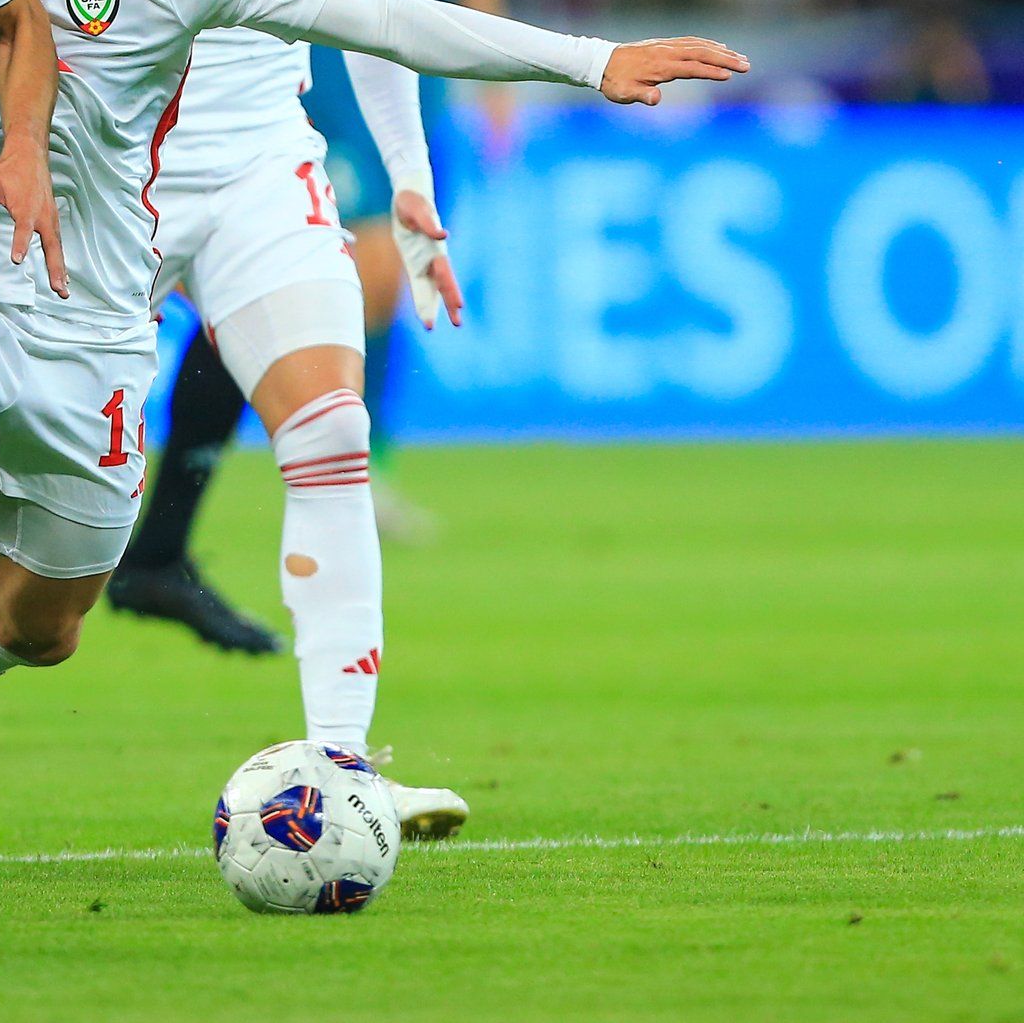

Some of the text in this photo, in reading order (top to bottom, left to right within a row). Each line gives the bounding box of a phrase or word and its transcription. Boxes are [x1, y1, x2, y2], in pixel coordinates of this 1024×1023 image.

[87, 2, 100, 10] FA
[294, 161, 337, 227] 1
[824, 158, 1024, 400] O
[98, 388, 145, 467] 1
[347, 794, 390, 858] molten
